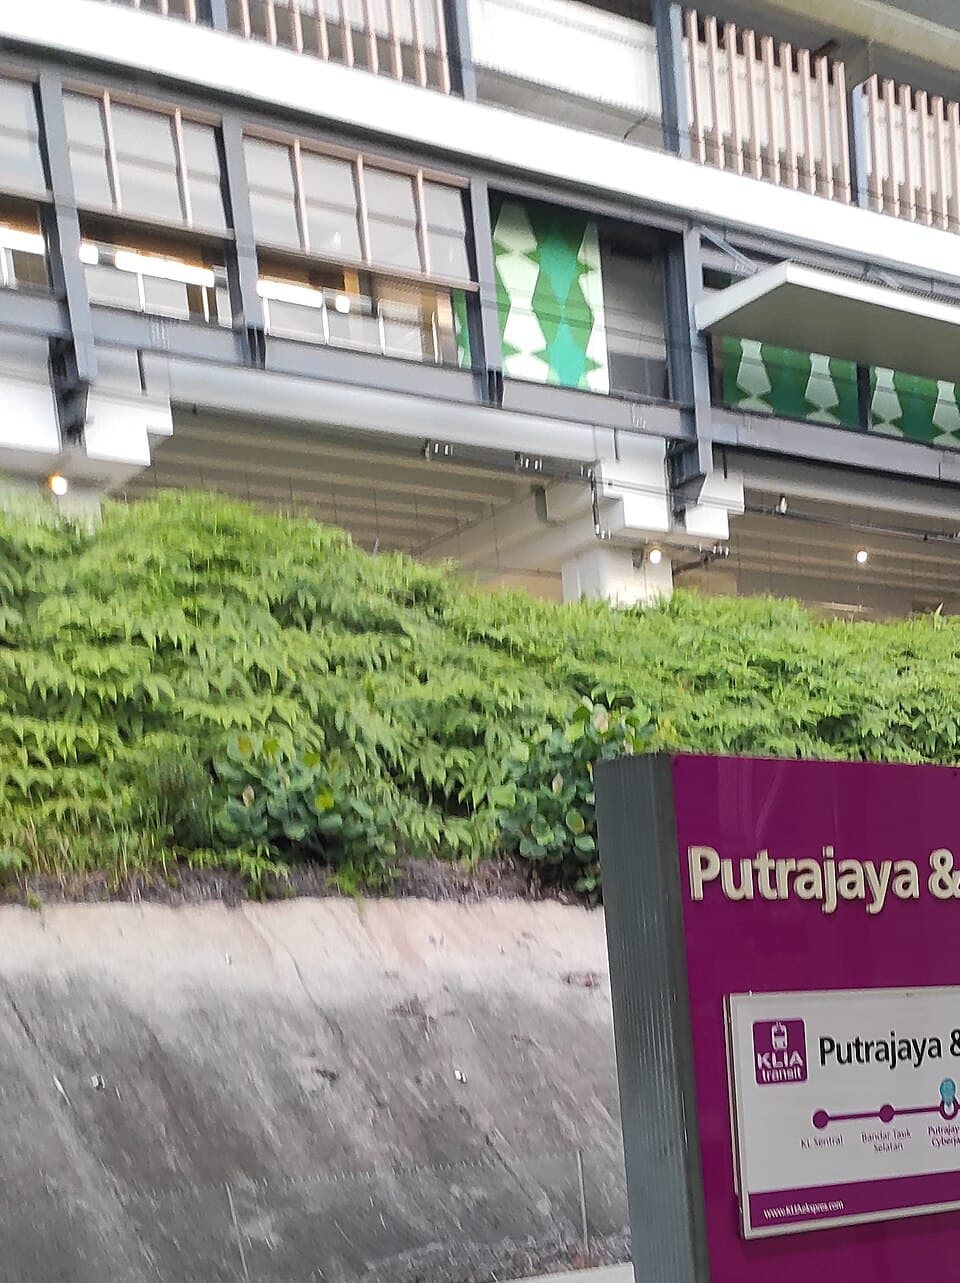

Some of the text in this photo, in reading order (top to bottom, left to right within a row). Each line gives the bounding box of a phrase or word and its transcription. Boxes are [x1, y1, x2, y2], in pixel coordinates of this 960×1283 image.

[687, 845, 919, 914] Putrajaya
[756, 1050, 803, 1069] KLIA
[819, 1031, 942, 1069] Putrajaya
[762, 1066, 802, 1082] transit
